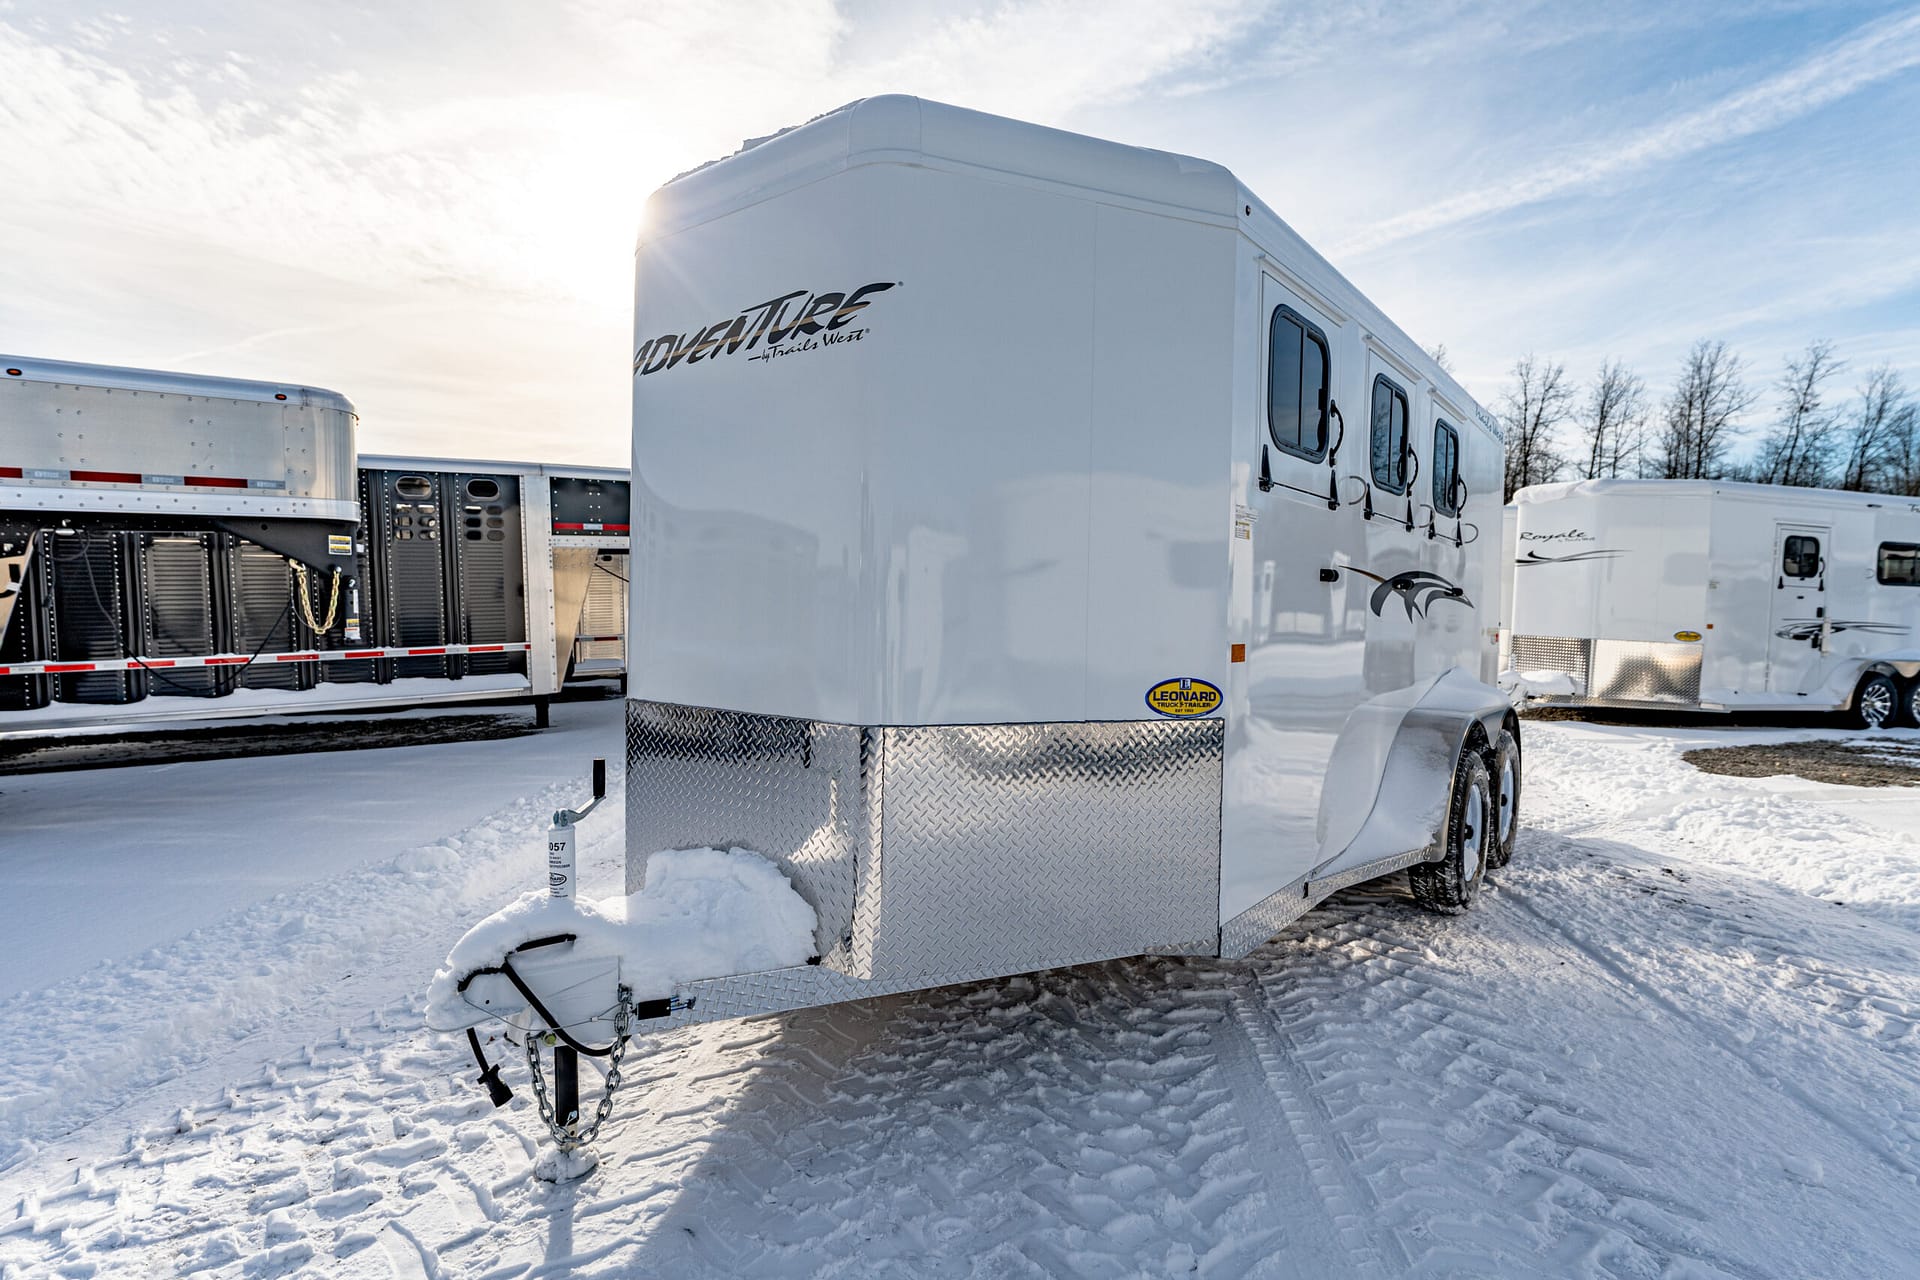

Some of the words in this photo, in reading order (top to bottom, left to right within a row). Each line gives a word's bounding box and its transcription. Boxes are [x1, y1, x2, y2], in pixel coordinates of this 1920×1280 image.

[633, 282, 896, 376] ADVENTURE
[769, 338, 818, 359] Trails
[823, 328, 865, 347] West
[1519, 528, 1586, 543] Royale
[1153, 691, 1216, 701] LEONARD
